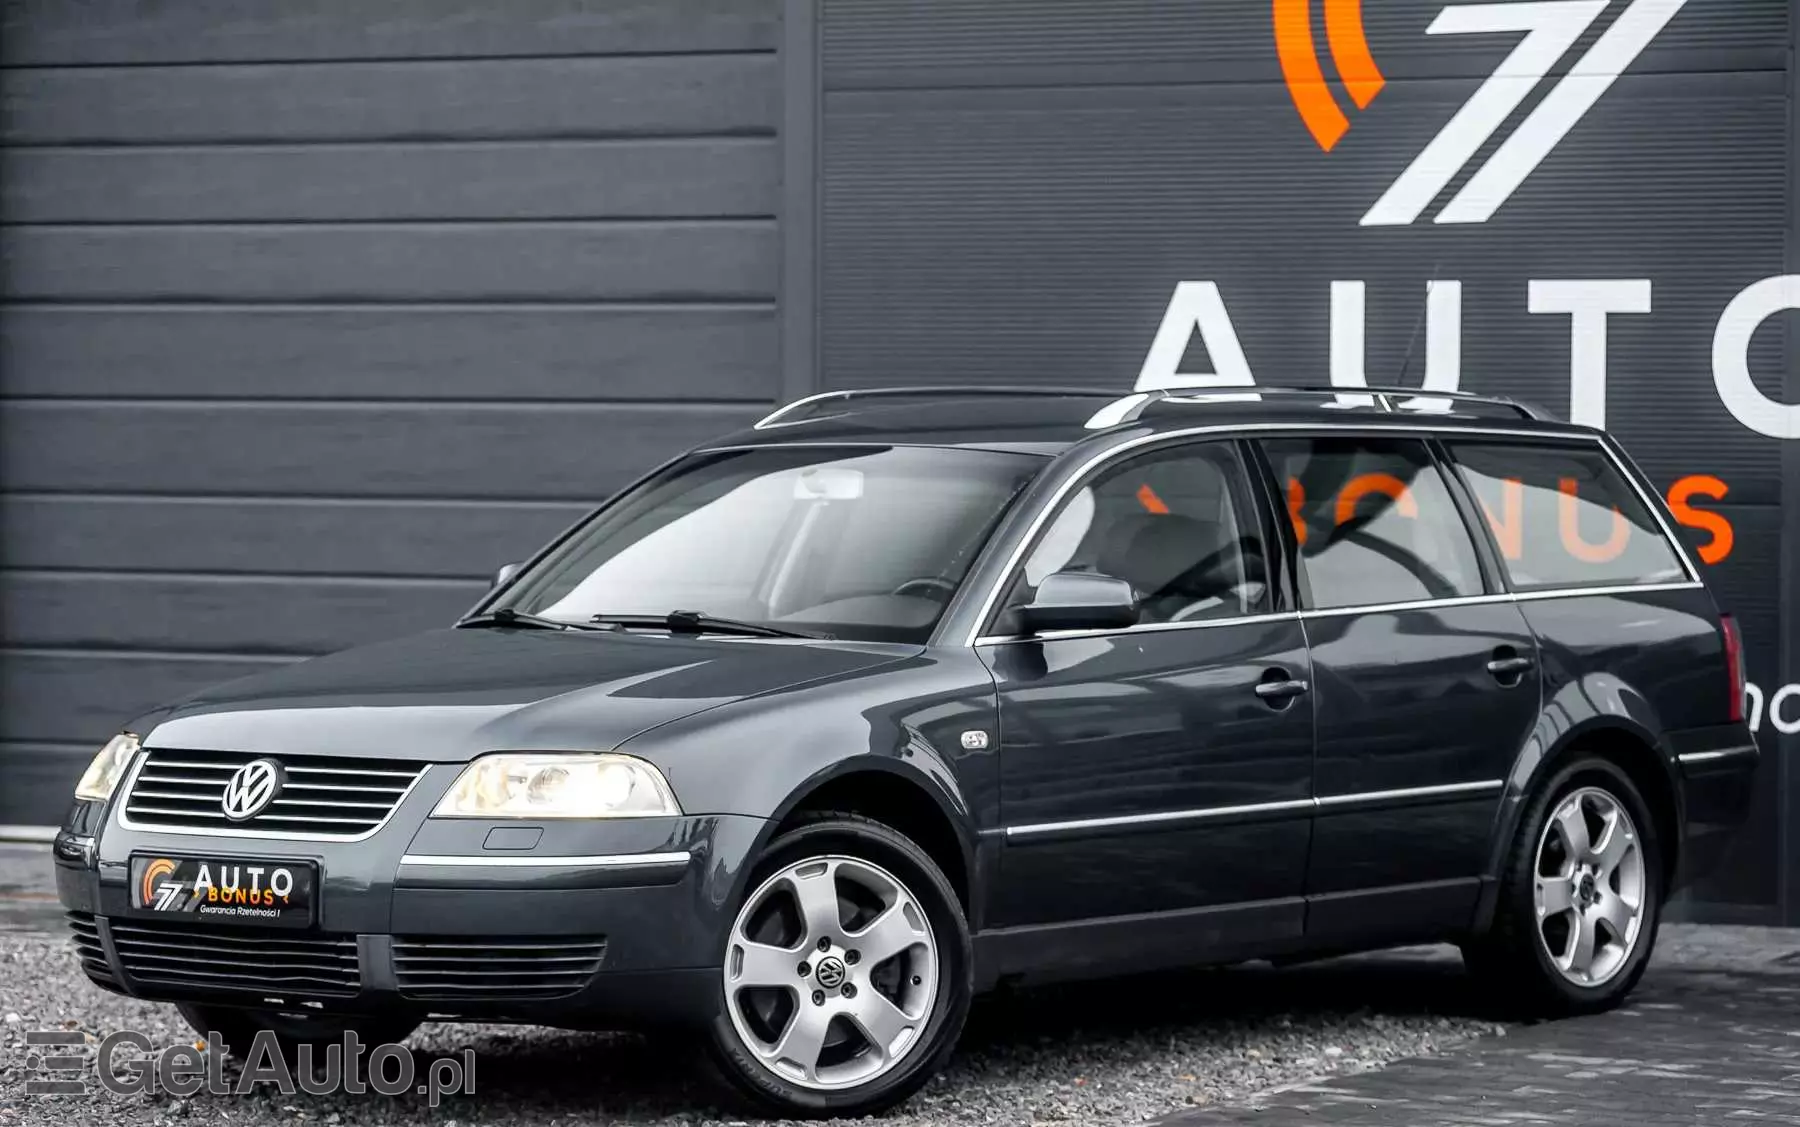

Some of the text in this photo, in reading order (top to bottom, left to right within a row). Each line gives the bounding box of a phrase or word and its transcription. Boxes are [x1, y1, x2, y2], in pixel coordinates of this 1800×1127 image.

[1134, 274, 1800, 438] AUTO
[193, 864, 293, 896] AUTO
[208, 886, 274, 905] BONUS
